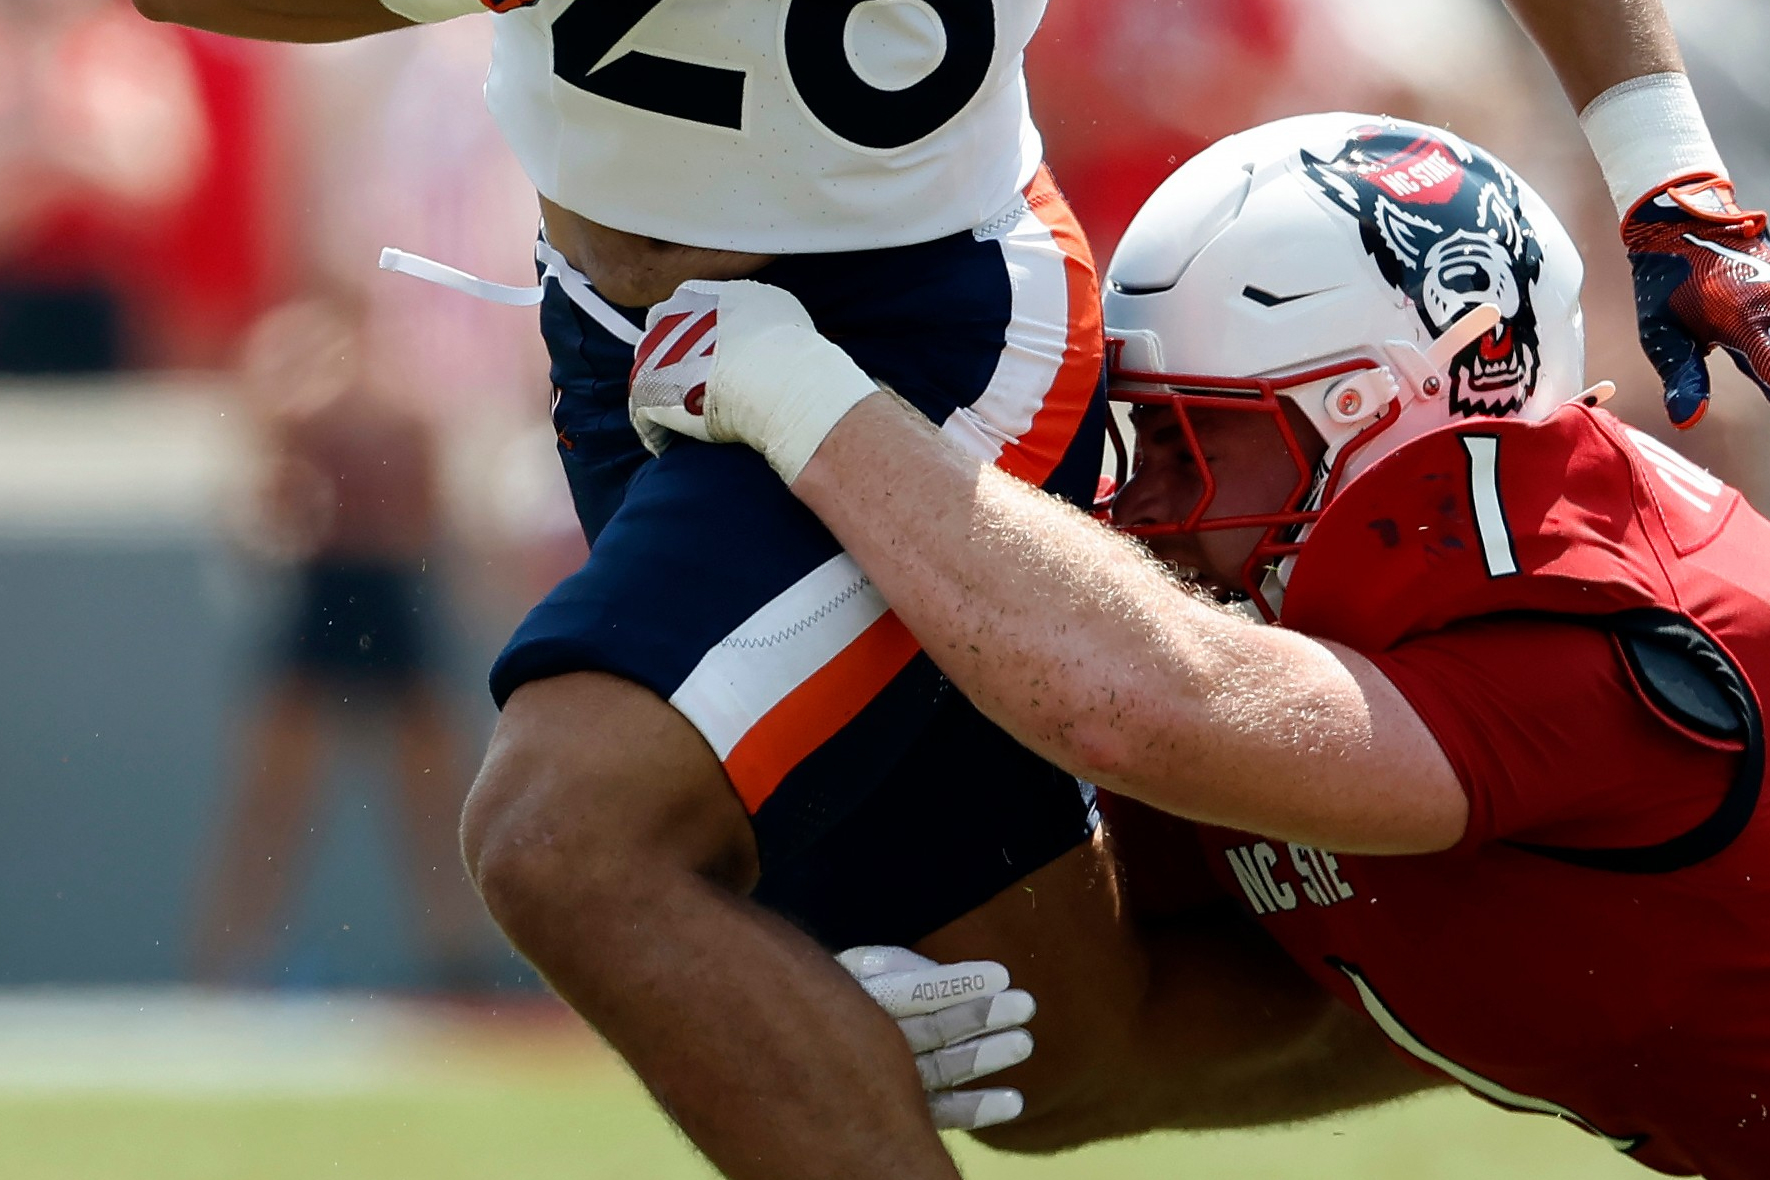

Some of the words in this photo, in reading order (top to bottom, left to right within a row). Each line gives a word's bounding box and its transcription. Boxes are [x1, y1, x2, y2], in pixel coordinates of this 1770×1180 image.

[1379, 170, 1421, 197] NC
[1407, 148, 1458, 188] STATE
[1456, 432, 1522, 580] 1
[1224, 841, 1297, 915] NC
[910, 973, 986, 1002] ADIZERO
